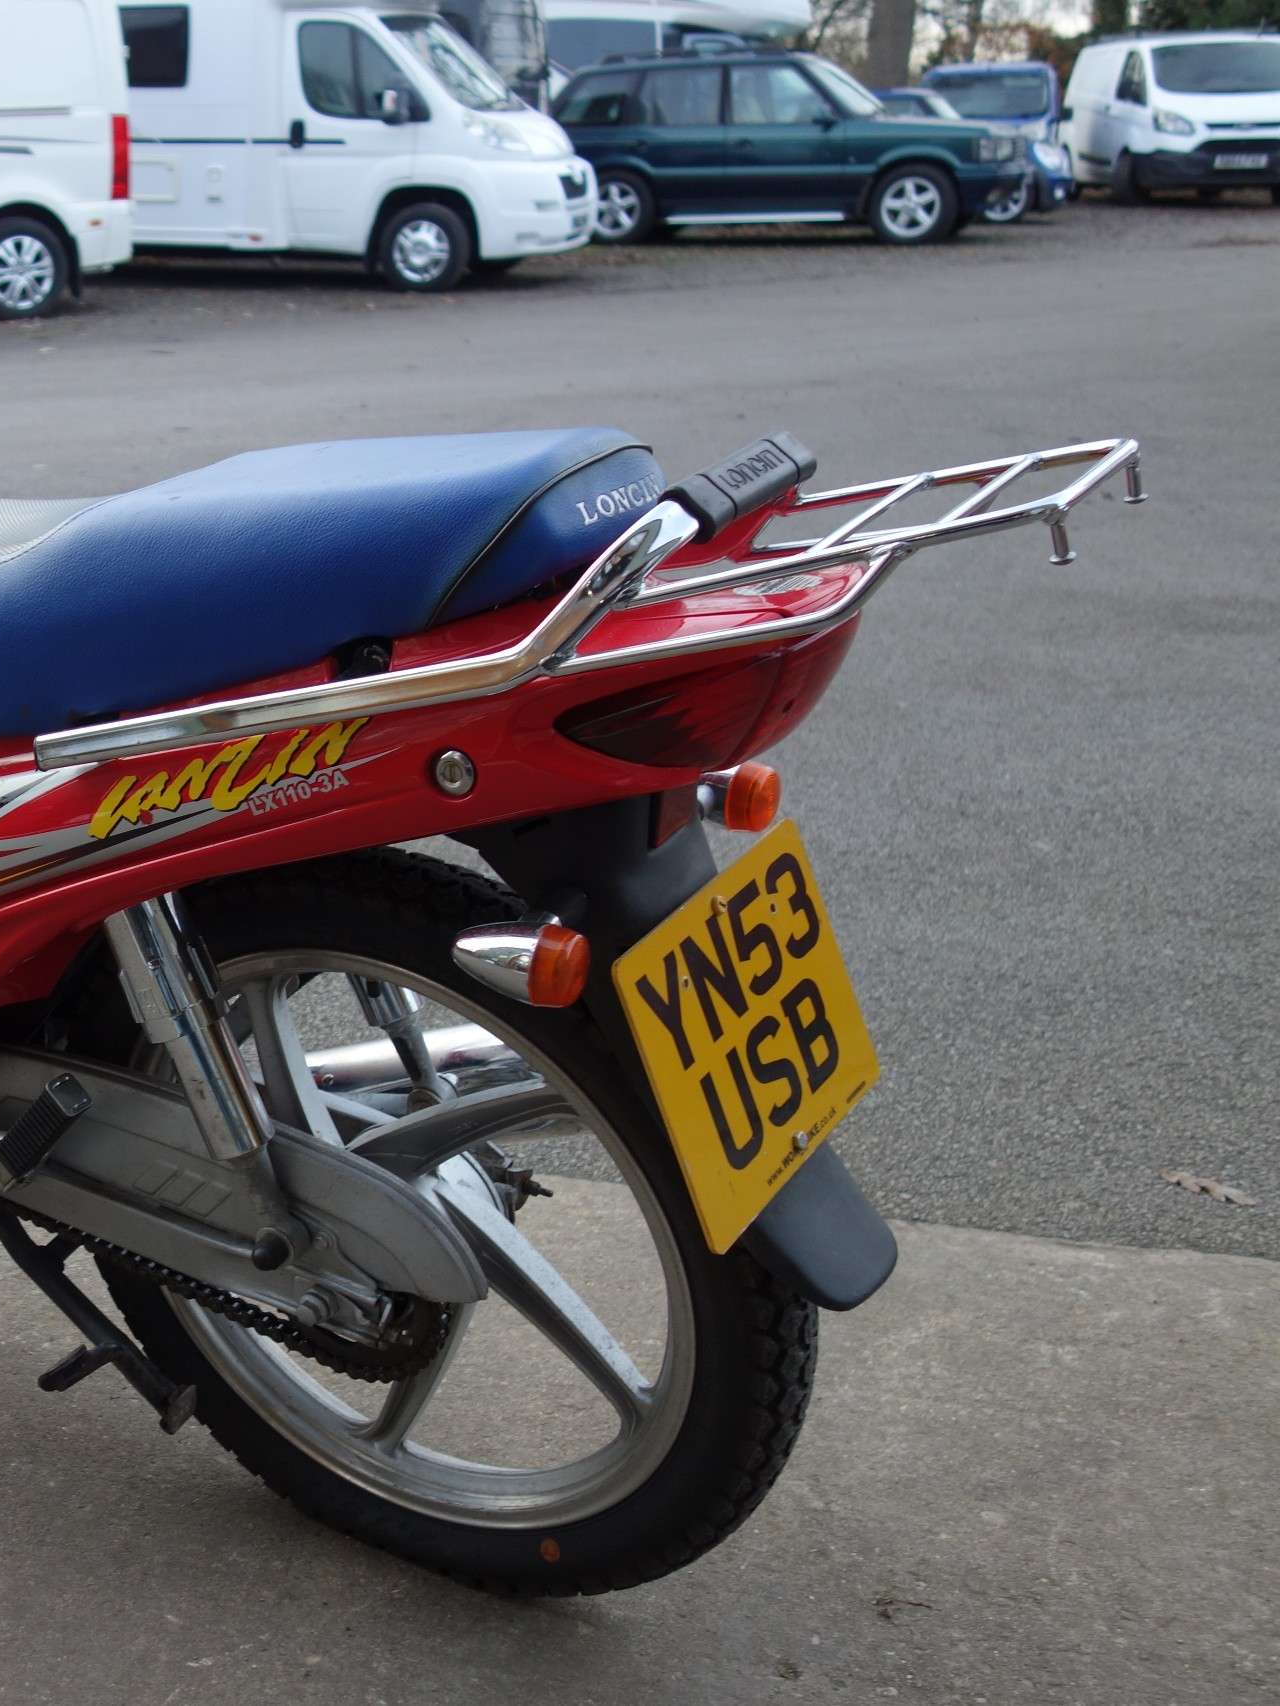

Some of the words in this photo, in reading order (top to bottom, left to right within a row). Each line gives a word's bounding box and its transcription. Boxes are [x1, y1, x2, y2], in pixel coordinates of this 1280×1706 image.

[246, 769, 350, 817] LX110-3A
[634, 852, 821, 1071] YN53
[699, 977, 840, 1171] USB
